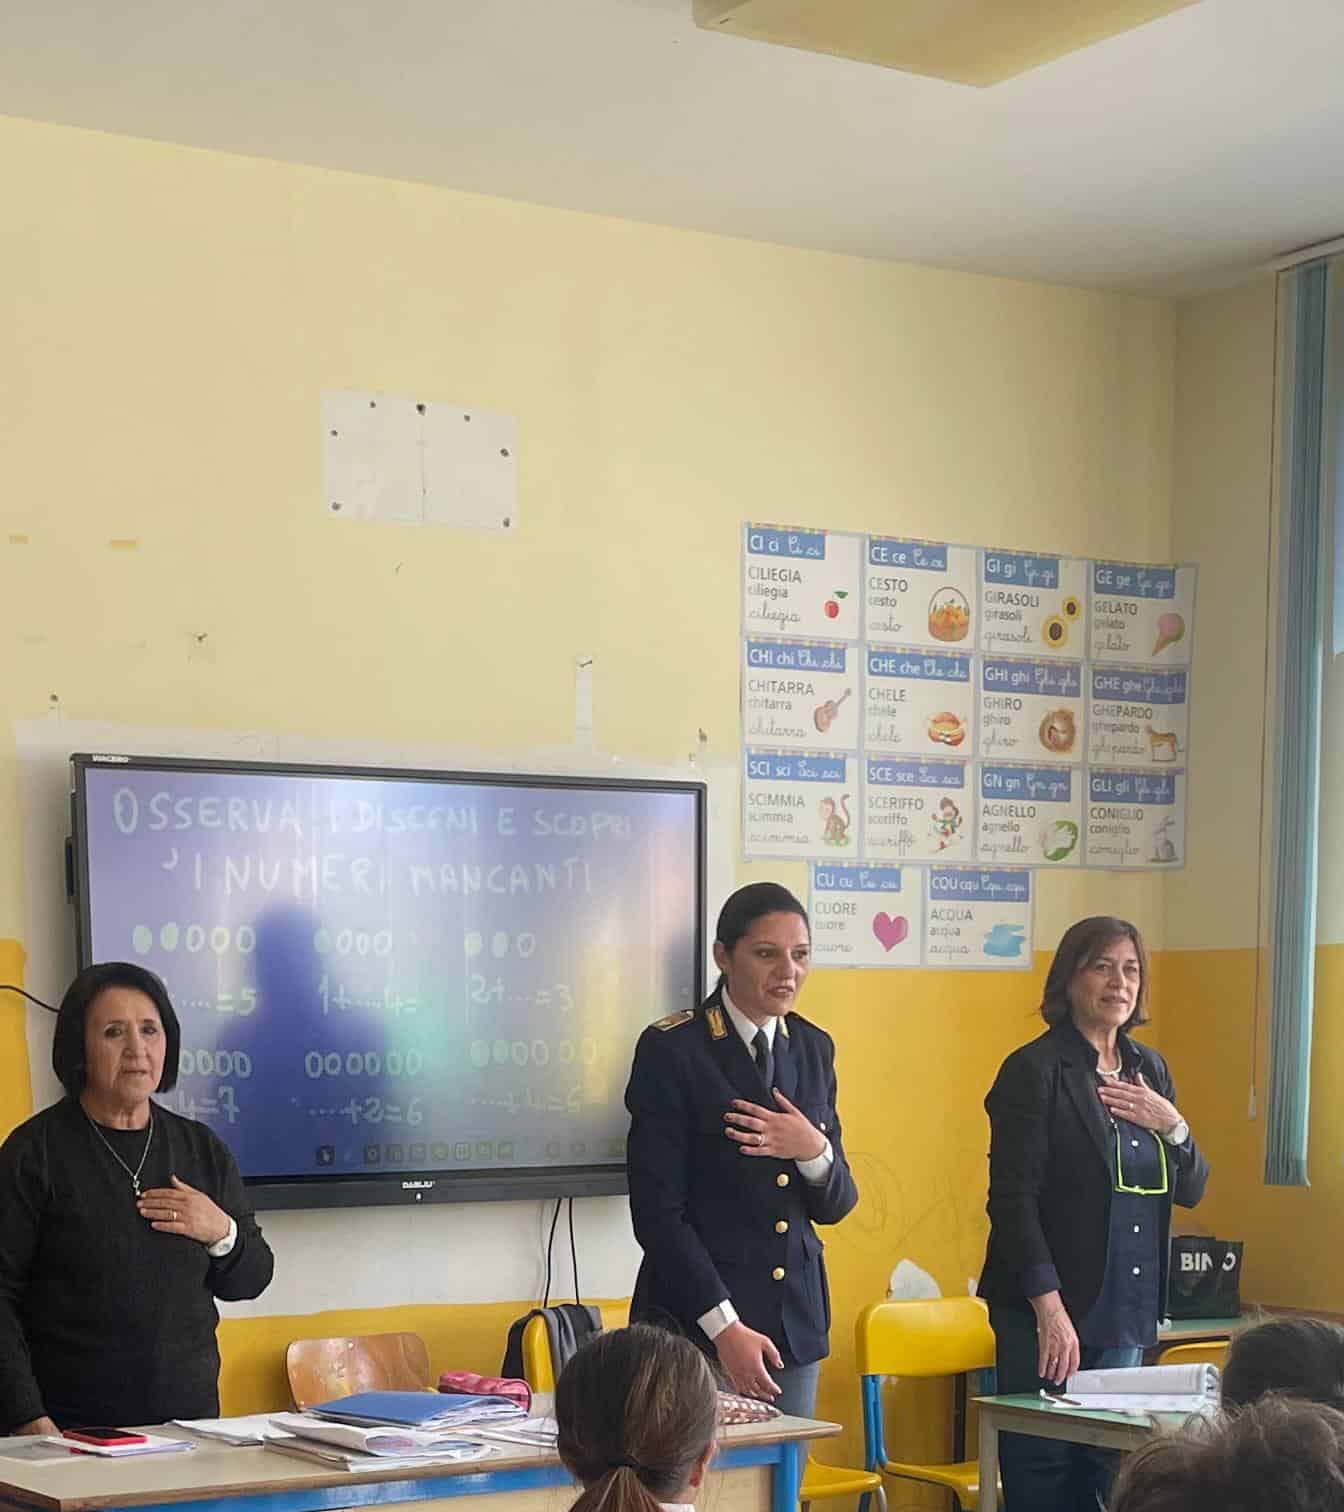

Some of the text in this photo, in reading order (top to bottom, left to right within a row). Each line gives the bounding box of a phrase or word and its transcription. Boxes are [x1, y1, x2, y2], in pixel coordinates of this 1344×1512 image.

[872, 547, 888, 562] CE
[987, 559, 1001, 573] GI
[748, 566, 801, 583] CILIEGIA
[748, 583, 788, 600] ciliegia
[869, 577, 908, 592] CESTO
[869, 596, 897, 607] cesto
[985, 591, 1039, 607] GIRASOLI
[748, 601, 801, 630] ciliegia
[1094, 601, 1138, 616] GELATO
[984, 609, 1022, 623] girasoli
[1094, 619, 1125, 631] gelato
[751, 650, 773, 664] CHI
[870, 658, 895, 672] CHE
[900, 661, 920, 673] che
[748, 680, 815, 696] CHITARRA
[869, 688, 906, 702] CHELE
[748, 699, 792, 711] chitarra
[869, 705, 896, 717] chele
[984, 697, 1022, 711] GHIRO
[1093, 705, 1152, 720] GHEPARDO
[983, 713, 1011, 727] ghiro
[870, 767, 892, 781] SCE
[748, 792, 805, 808] SCIMMIA
[868, 796, 924, 810] SCERIFFO
[113, 788, 304, 837] OSSERVA
[498, 808, 516, 834] E
[532, 809, 632, 840] SCOPRI
[748, 811, 793, 824] scimmia
[982, 805, 1036, 818] AGNELLO
[1090, 808, 1144, 821] CONIGLIO
[868, 813, 908, 825] sceriffo
[982, 820, 1020, 833] agnello
[225, 854, 386, 898] NUMERI
[410, 858, 592, 896] MANCANTI
[815, 902, 856, 914] CUORE
[930, 909, 973, 922] ACQUA
[815, 920, 845, 930] cuore
[930, 927, 961, 937] acqua
